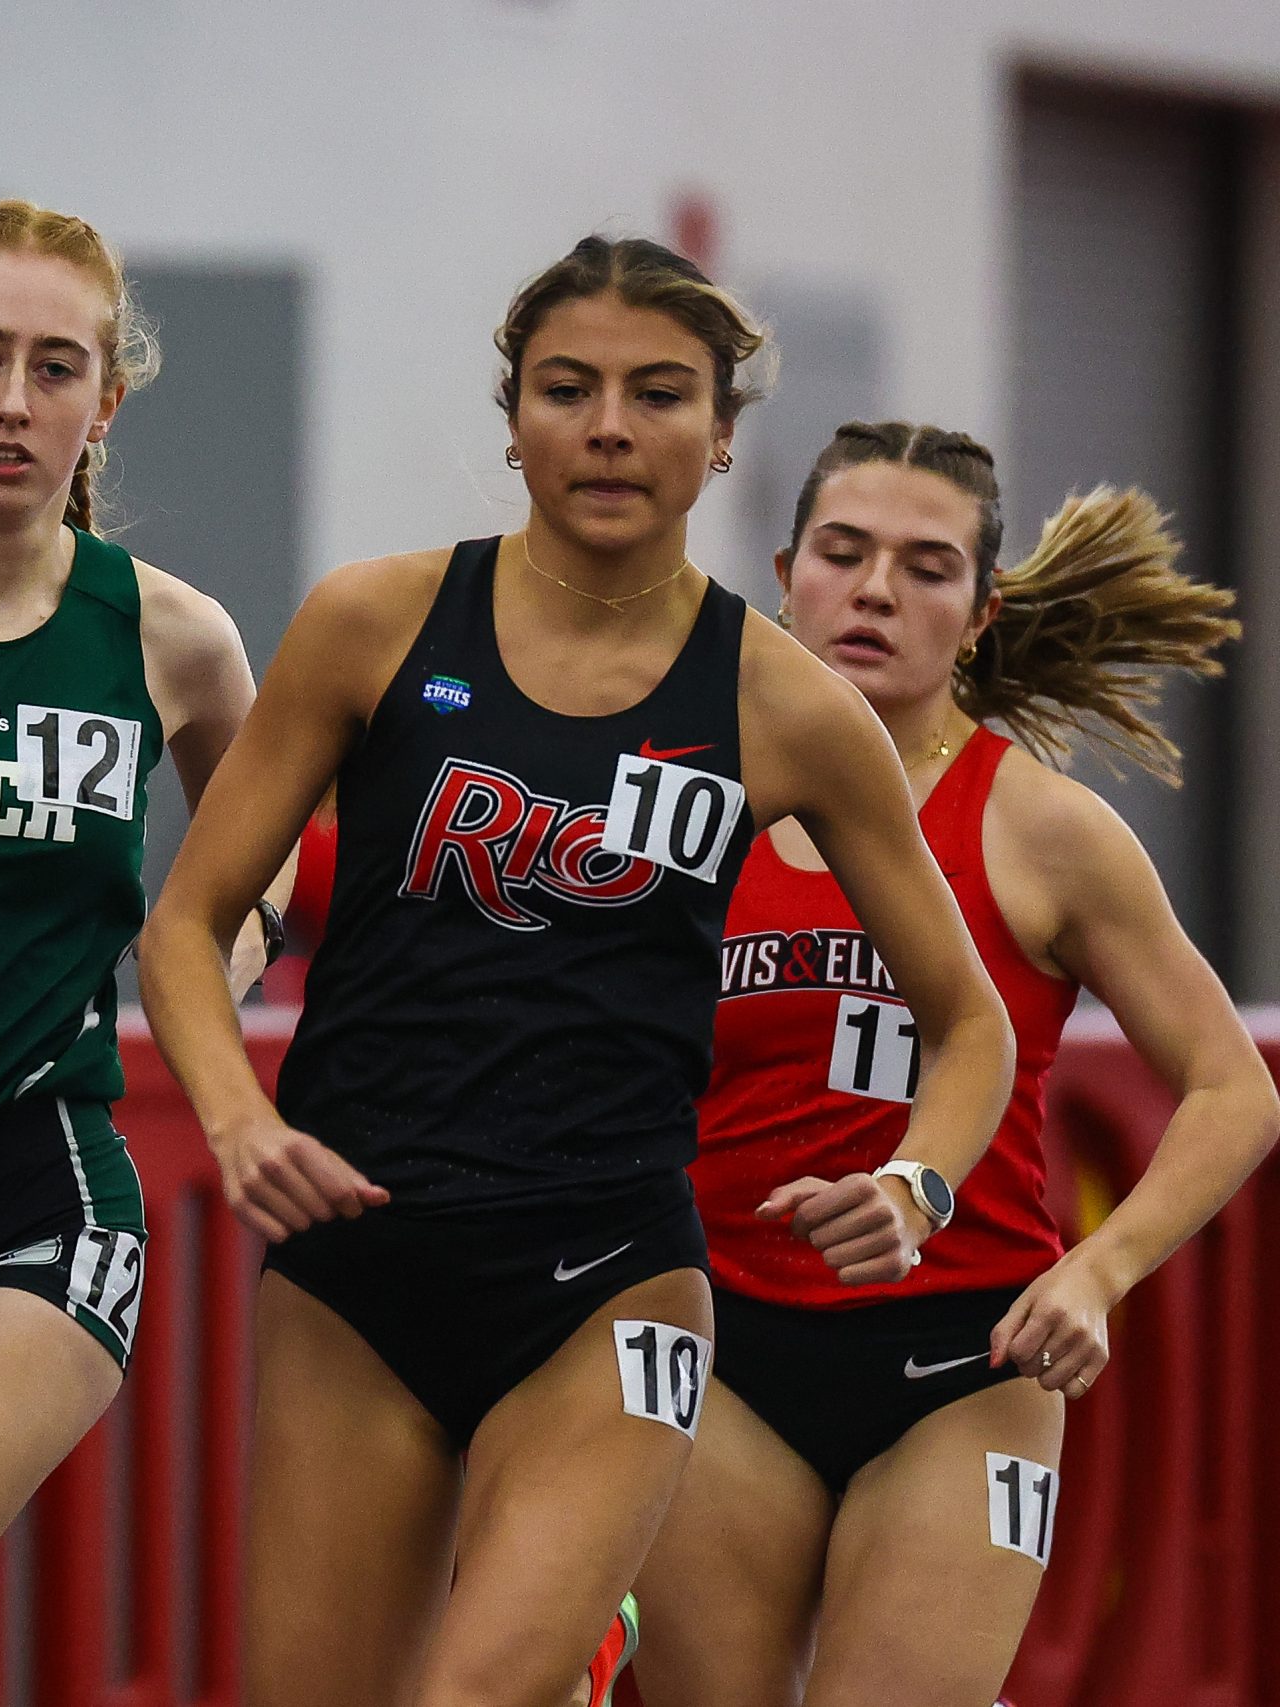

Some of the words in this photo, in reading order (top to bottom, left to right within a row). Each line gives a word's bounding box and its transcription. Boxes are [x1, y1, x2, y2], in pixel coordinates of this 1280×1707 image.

[423, 683, 471, 707] STATES
[26, 712, 121, 812] 12
[624, 764, 726, 871] 10
[845, 1003, 921, 1099] 11
[85, 1230, 141, 1343] 12
[625, 1325, 699, 1430] 10
[995, 1460, 1052, 1559] 11
